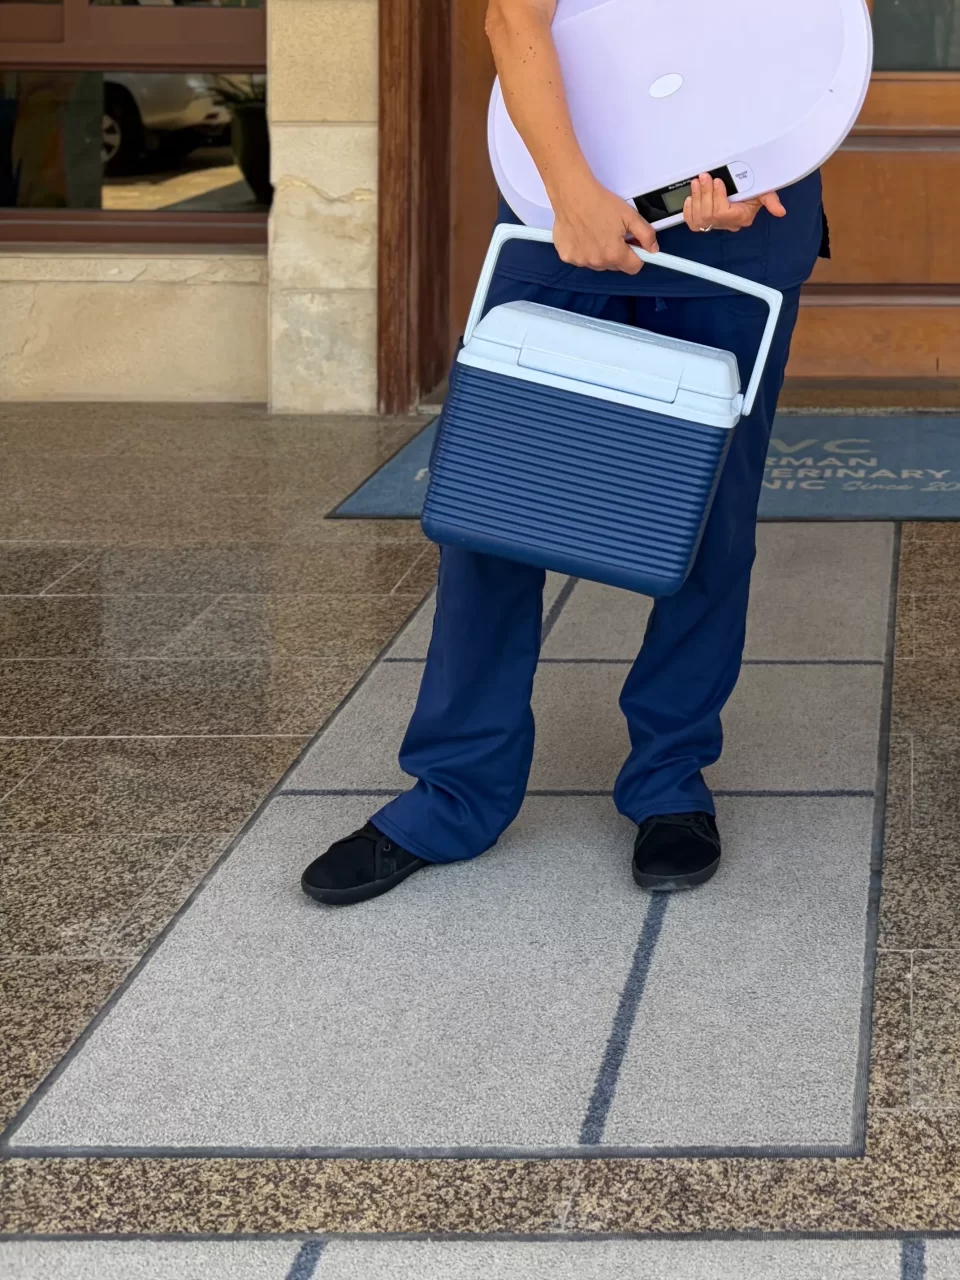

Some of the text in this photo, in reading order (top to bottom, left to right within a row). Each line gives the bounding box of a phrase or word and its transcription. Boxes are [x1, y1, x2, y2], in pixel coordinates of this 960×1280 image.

[770, 438, 872, 454] VC
[765, 456, 878, 467] RMAN
[764, 468, 951, 479] ERINARY
[761, 480, 827, 490] NIC
